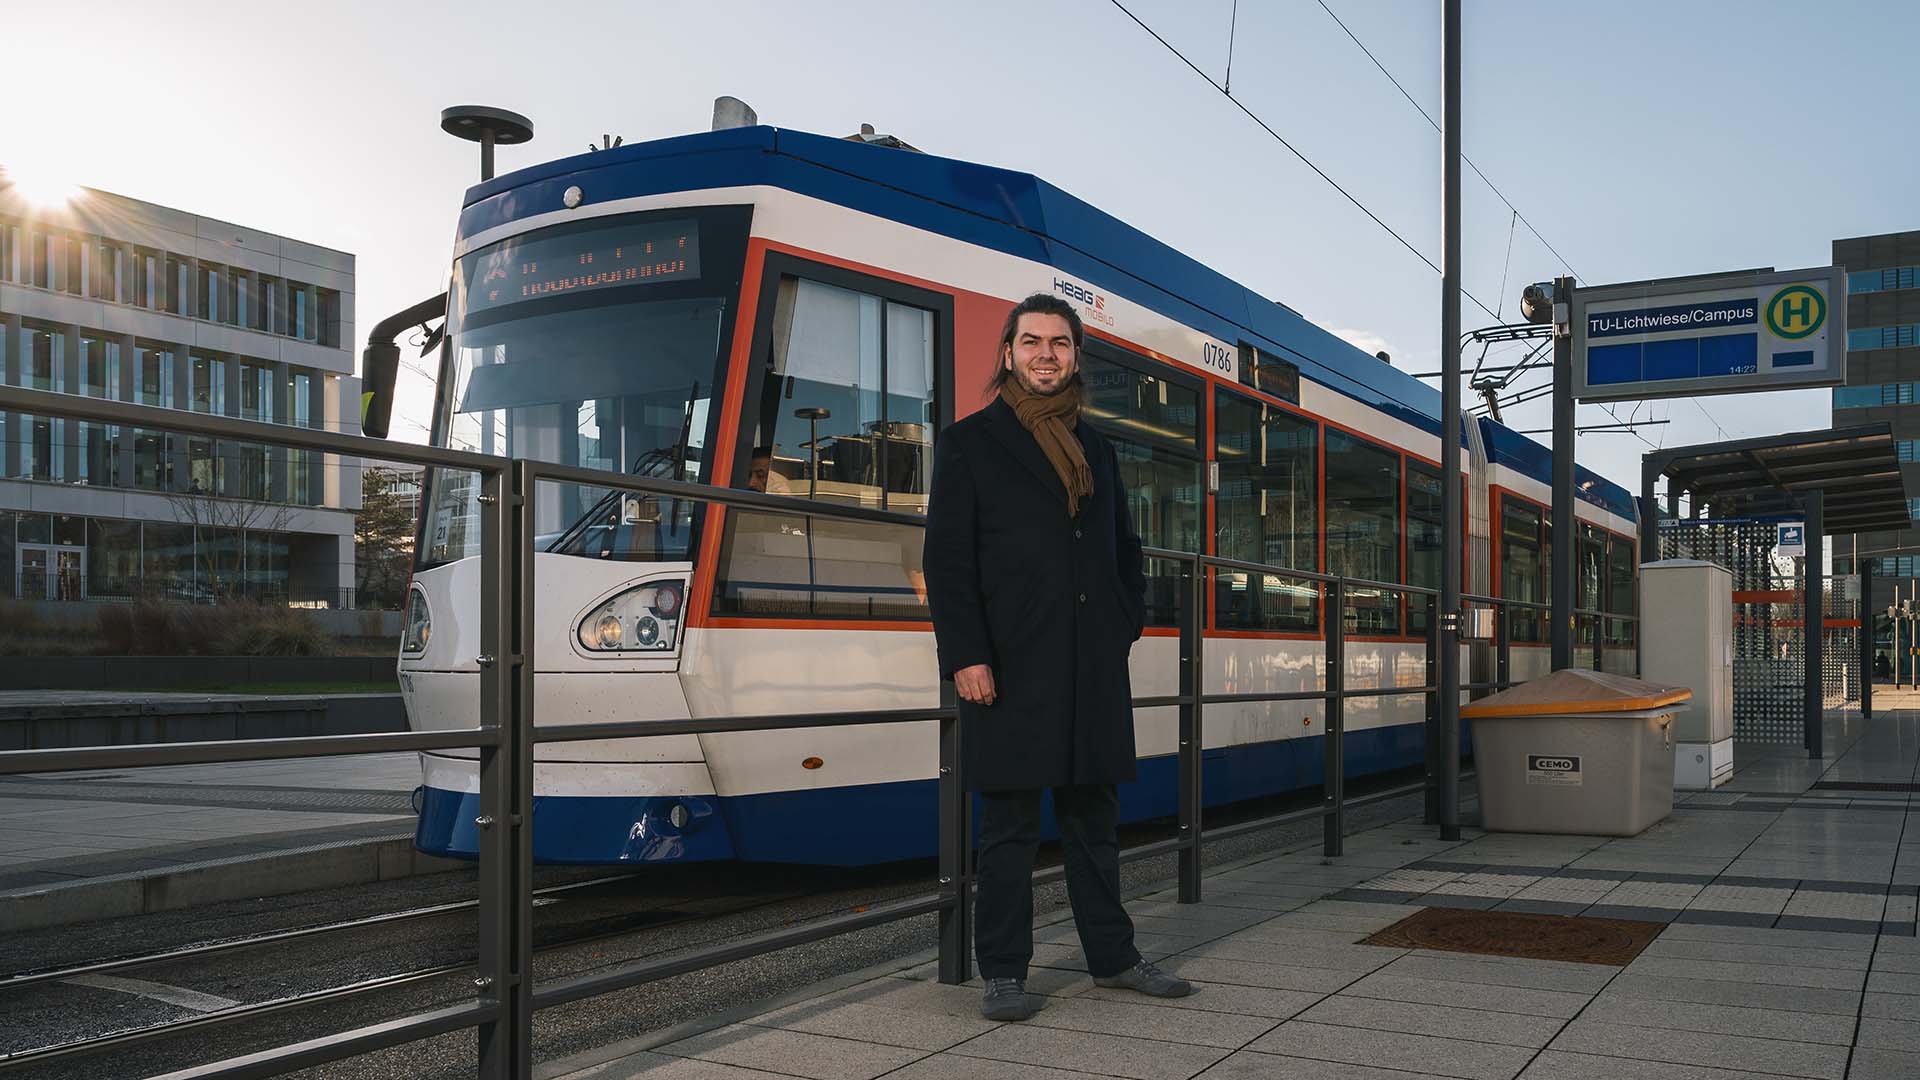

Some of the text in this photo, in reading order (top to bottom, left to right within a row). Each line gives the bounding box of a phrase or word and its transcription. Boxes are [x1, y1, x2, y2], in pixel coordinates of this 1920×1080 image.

[1590, 306, 1754, 333] TU-Lichtwiese/Campus
[1782, 297, 1810, 327] H
[1203, 341, 1232, 373] 0786
[437, 526, 447, 540] 21
[1538, 760, 1570, 769] CEMO
